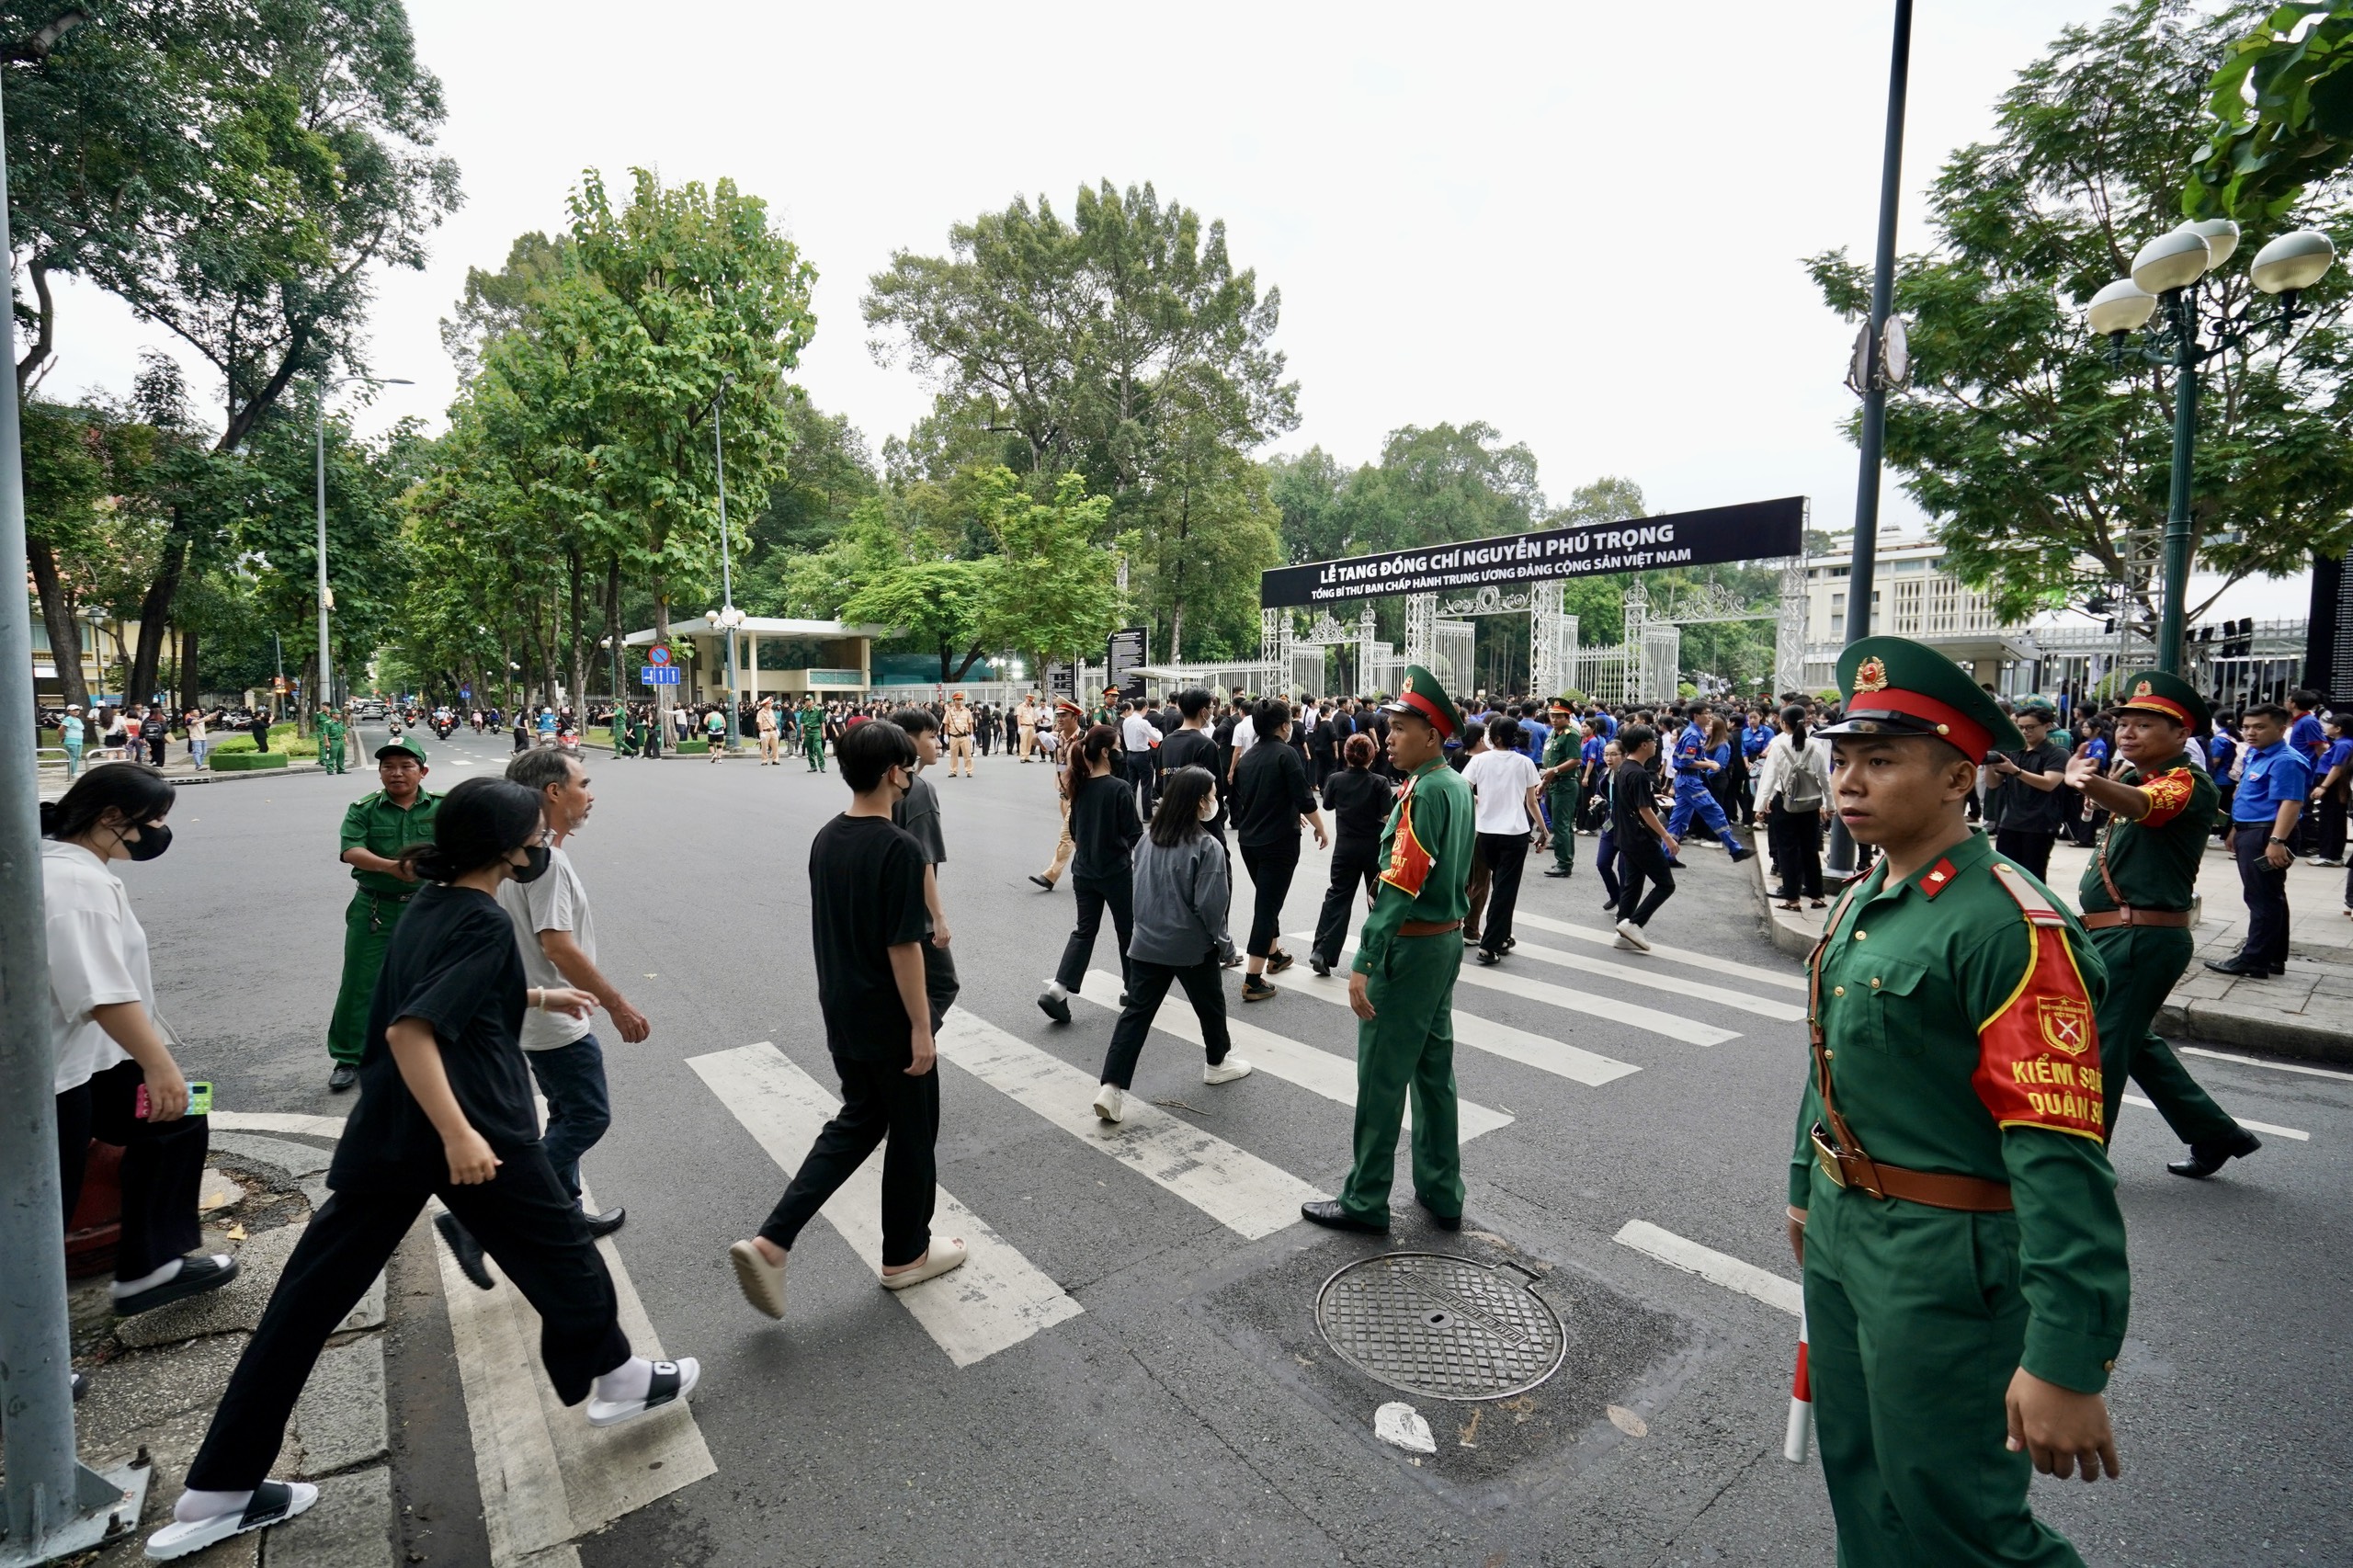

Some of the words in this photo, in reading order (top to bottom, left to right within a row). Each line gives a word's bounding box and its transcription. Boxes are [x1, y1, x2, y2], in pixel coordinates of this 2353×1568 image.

[1312, 587, 1335, 600] TỔNG
[1336, 585, 1345, 597] BÍ
[1345, 584, 1364, 596] THƯ
[1365, 582, 1383, 594] BAN
[1385, 577, 1412, 591] CHẤP
[1413, 576, 1442, 588] HÀNH
[1443, 572, 1479, 585] TRUNG
[1481, 567, 1515, 582] ƯƠNG
[1517, 562, 1552, 577] ĐẢNG
[1554, 559, 1592, 575] CỘNG
[1594, 554, 1620, 569] SẢN
[1622, 551, 1654, 568] VIỆT
[1655, 548, 1691, 563] NAM
[1320, 563, 1336, 585] LỄ
[1338, 562, 1377, 582] TANG
[1380, 555, 1427, 576] ĐỒNG
[1430, 549, 1461, 570] CHÍ
[1463, 537, 1541, 566] NGUYỄN
[1546, 531, 1590, 556] PHÚ
[1593, 524, 1674, 551] TRỌNG
[2011, 1052, 2075, 1085] KIỂM
[2028, 1090, 2088, 1120] QUÂN
